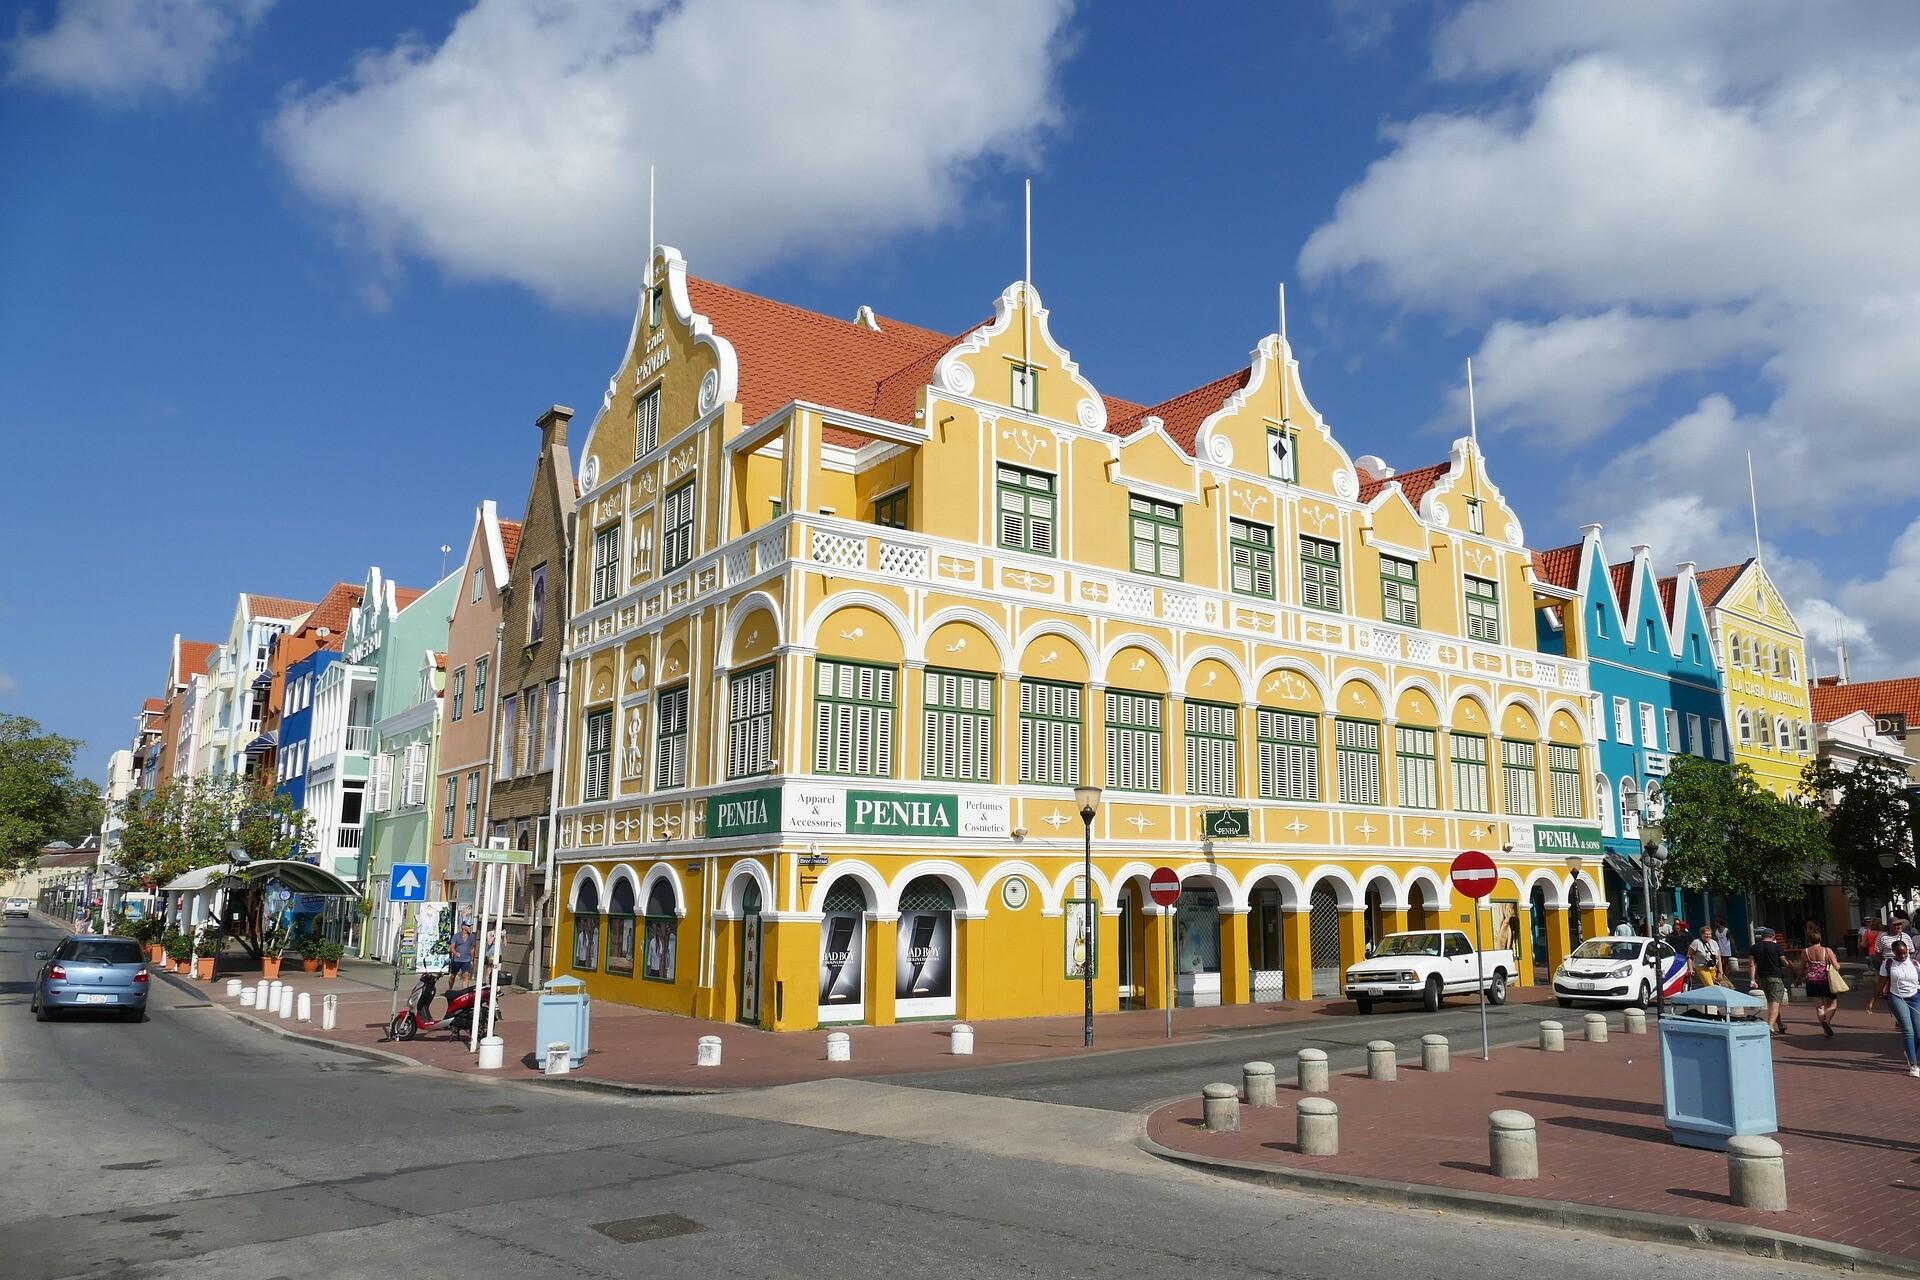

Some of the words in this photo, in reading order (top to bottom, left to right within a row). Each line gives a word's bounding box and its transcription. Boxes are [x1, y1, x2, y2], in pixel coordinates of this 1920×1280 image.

[636, 345, 670, 385] PENHA
[798, 793, 835, 805] Apparel
[812, 806, 820, 815] &
[966, 800, 1003, 811] Perfumes
[717, 798, 768, 828] PENHA
[854, 799, 951, 827] PENHA
[981, 814, 988, 822] &
[790, 817, 842, 828] Accessories
[964, 823, 1005, 833] Cosmetics
[1218, 827, 1239, 835] PENHA
[1537, 830, 1580, 849] PENHA
[1580, 840, 1586, 849] &
[1586, 841, 1600, 850] SONS
